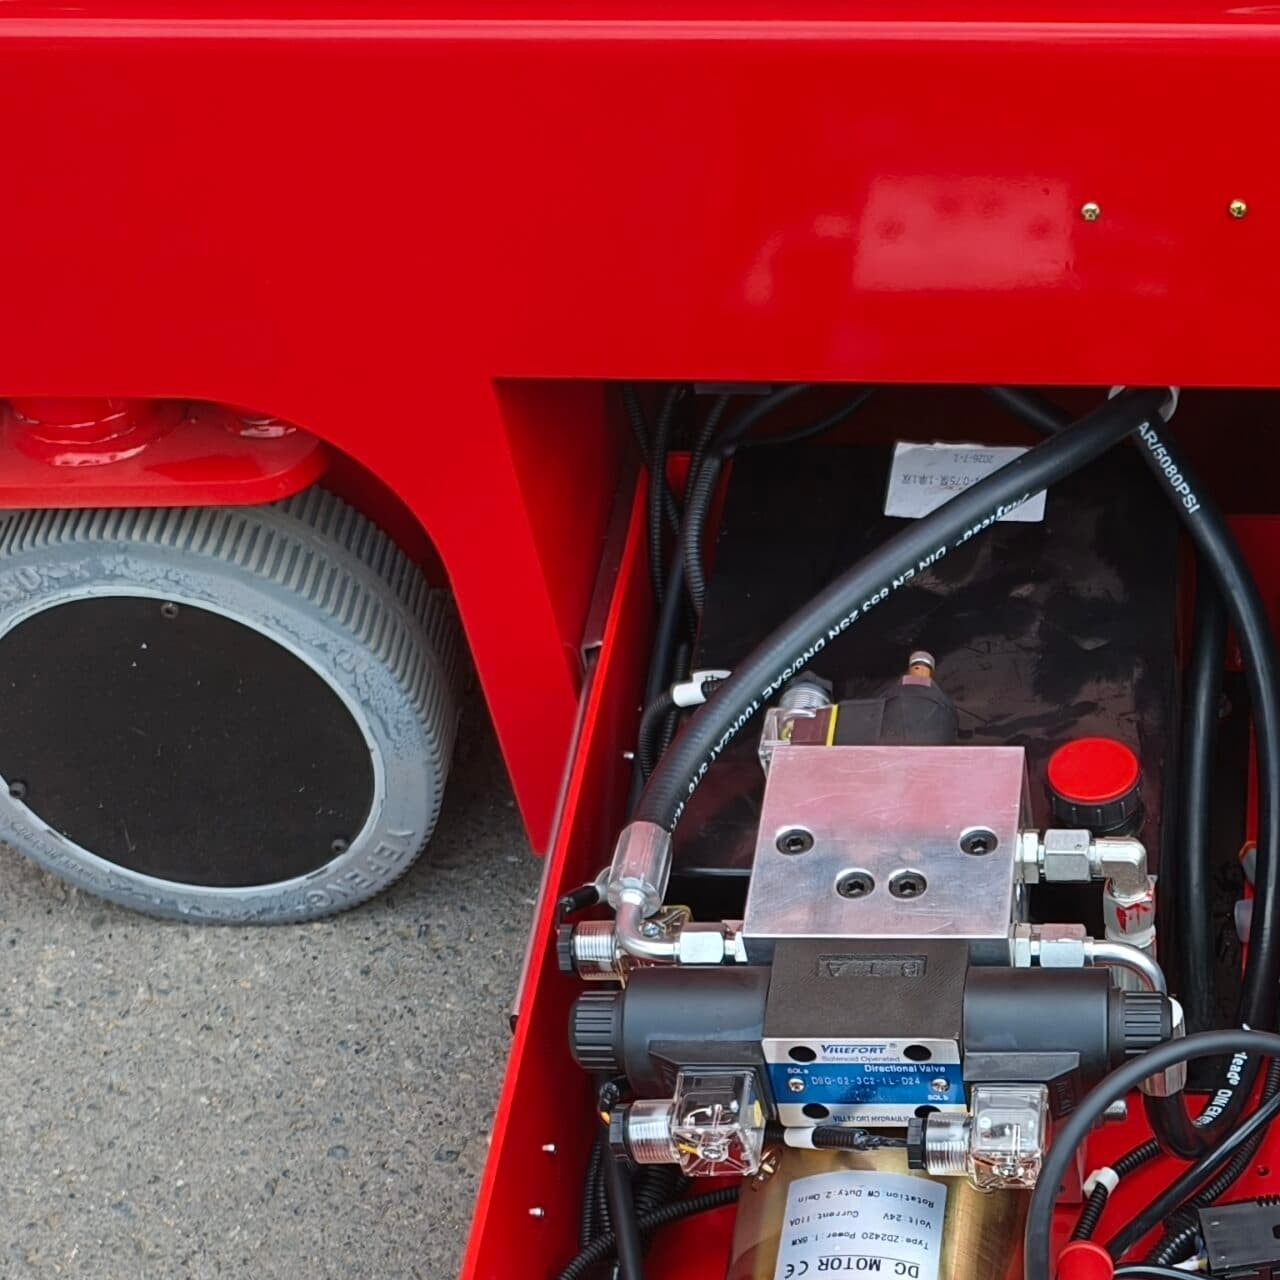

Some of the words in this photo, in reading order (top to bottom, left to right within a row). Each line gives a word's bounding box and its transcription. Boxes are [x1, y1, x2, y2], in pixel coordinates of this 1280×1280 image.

[820, 1043, 889, 1055] VILLEFORT
[863, 1063, 918, 1074] Directional
[918, 1064, 947, 1074] Valve
[817, 1257, 882, 1272] MOTOR
[893, 1261, 921, 1279] DC
